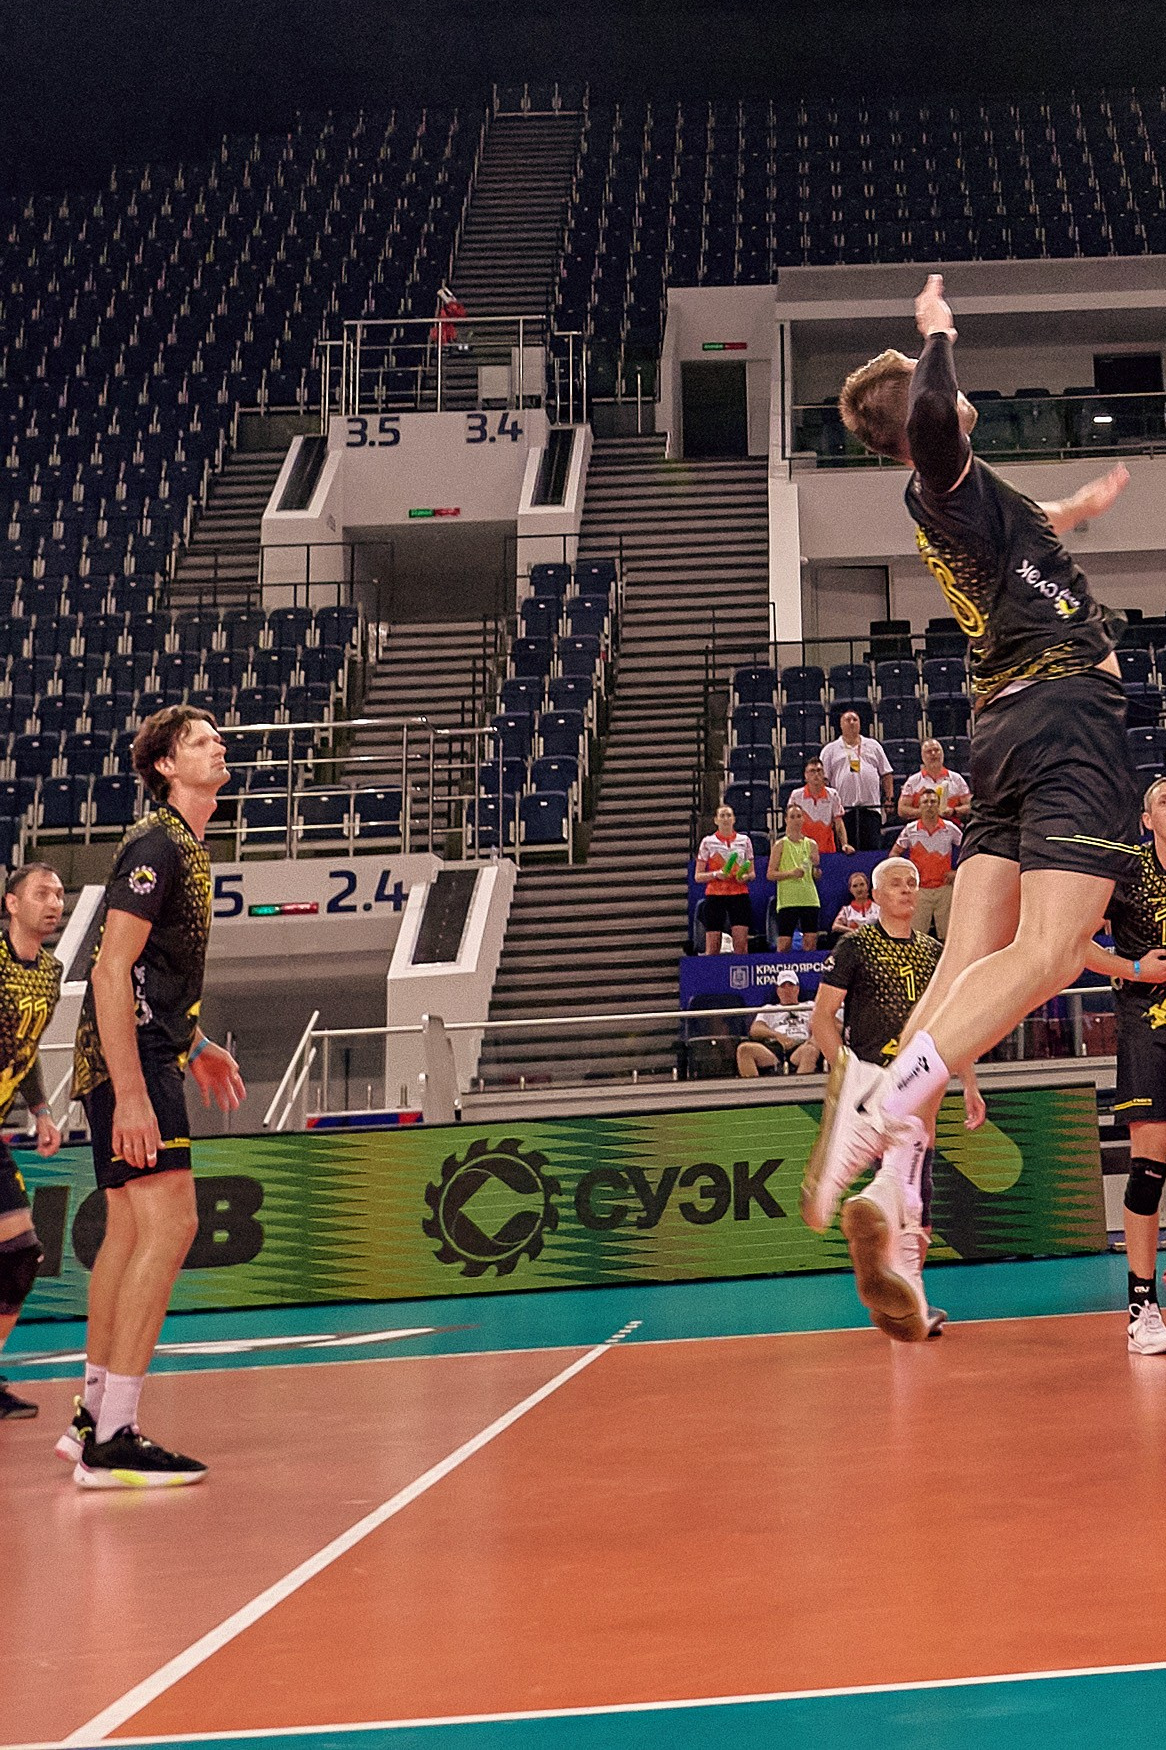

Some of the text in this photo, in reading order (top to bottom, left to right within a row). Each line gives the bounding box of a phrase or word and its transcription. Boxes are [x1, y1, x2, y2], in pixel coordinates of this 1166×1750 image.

[346, 416, 401, 447] 3.5
[466, 412, 523, 443] 3.4
[326, 869, 410, 913] 2.4
[574, 1158, 787, 1230] СУЭК
